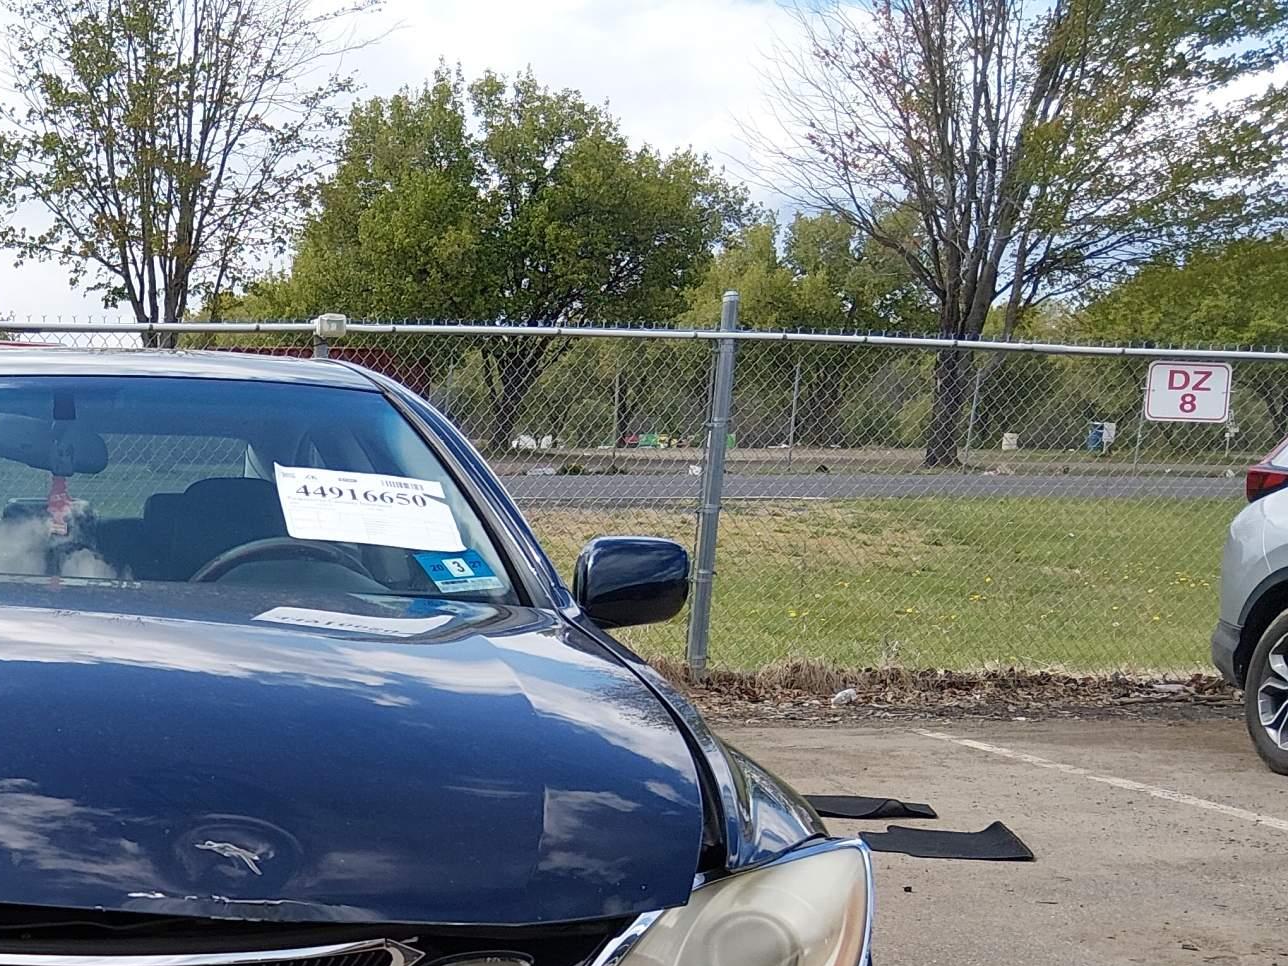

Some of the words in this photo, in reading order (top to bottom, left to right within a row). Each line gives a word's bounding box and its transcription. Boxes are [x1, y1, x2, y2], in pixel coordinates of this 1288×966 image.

[1167, 369, 1213, 392] DZ
[1179, 393, 1197, 413] 8
[295, 484, 428, 508] 44916650
[452, 560, 466, 573] 3
